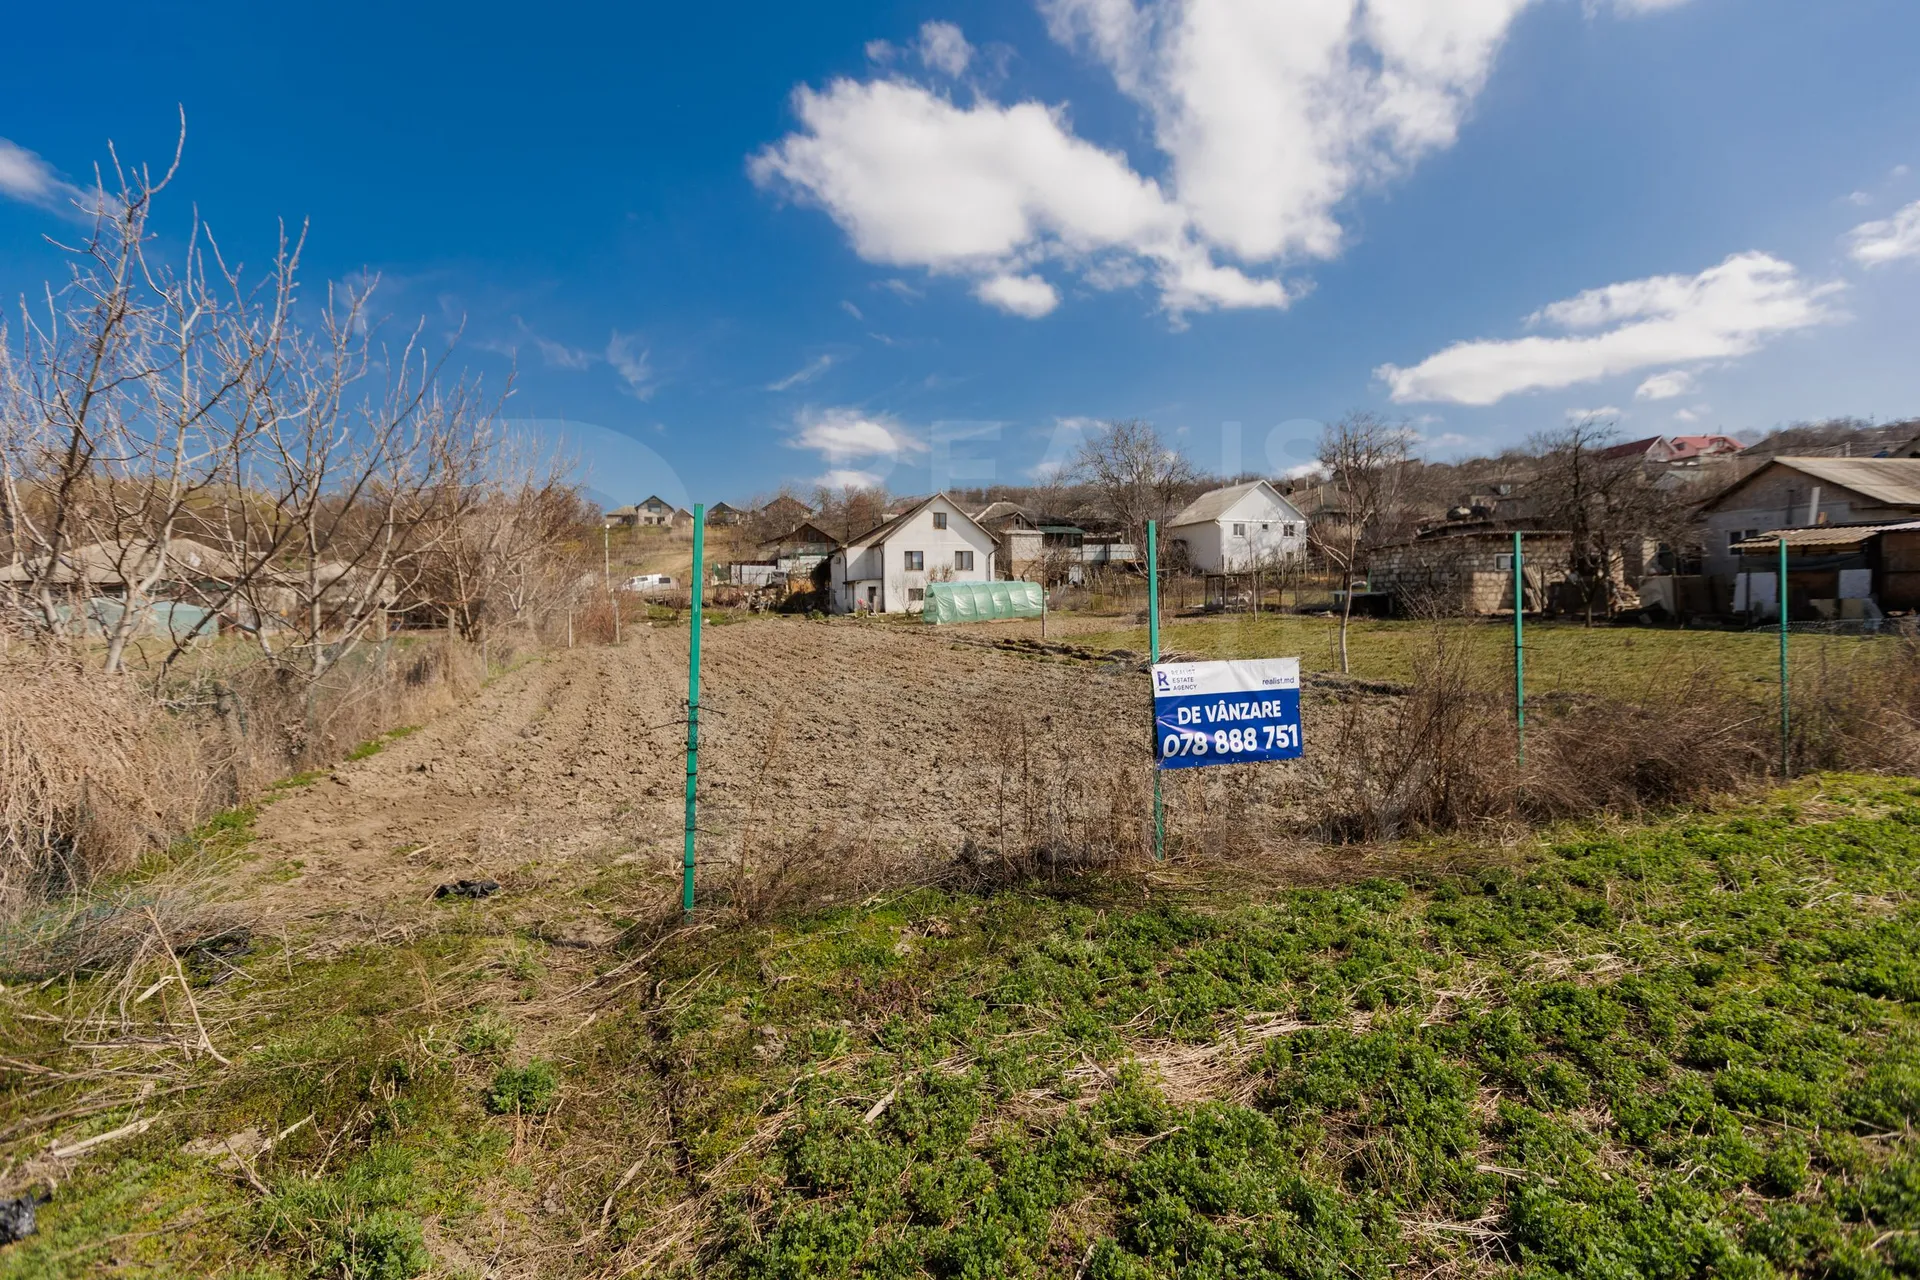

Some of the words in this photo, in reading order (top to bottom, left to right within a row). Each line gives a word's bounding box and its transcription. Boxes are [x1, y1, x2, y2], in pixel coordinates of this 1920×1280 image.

[1157, 671, 1170, 687] R
[1262, 676, 1295, 686] realist.md
[1177, 706, 1202, 725] DE
[1205, 700, 1282, 723] VÂNZARE
[1163, 732, 1208, 758] 078
[1214, 727, 1258, 754] 888
[1262, 723, 1299, 750] 751
